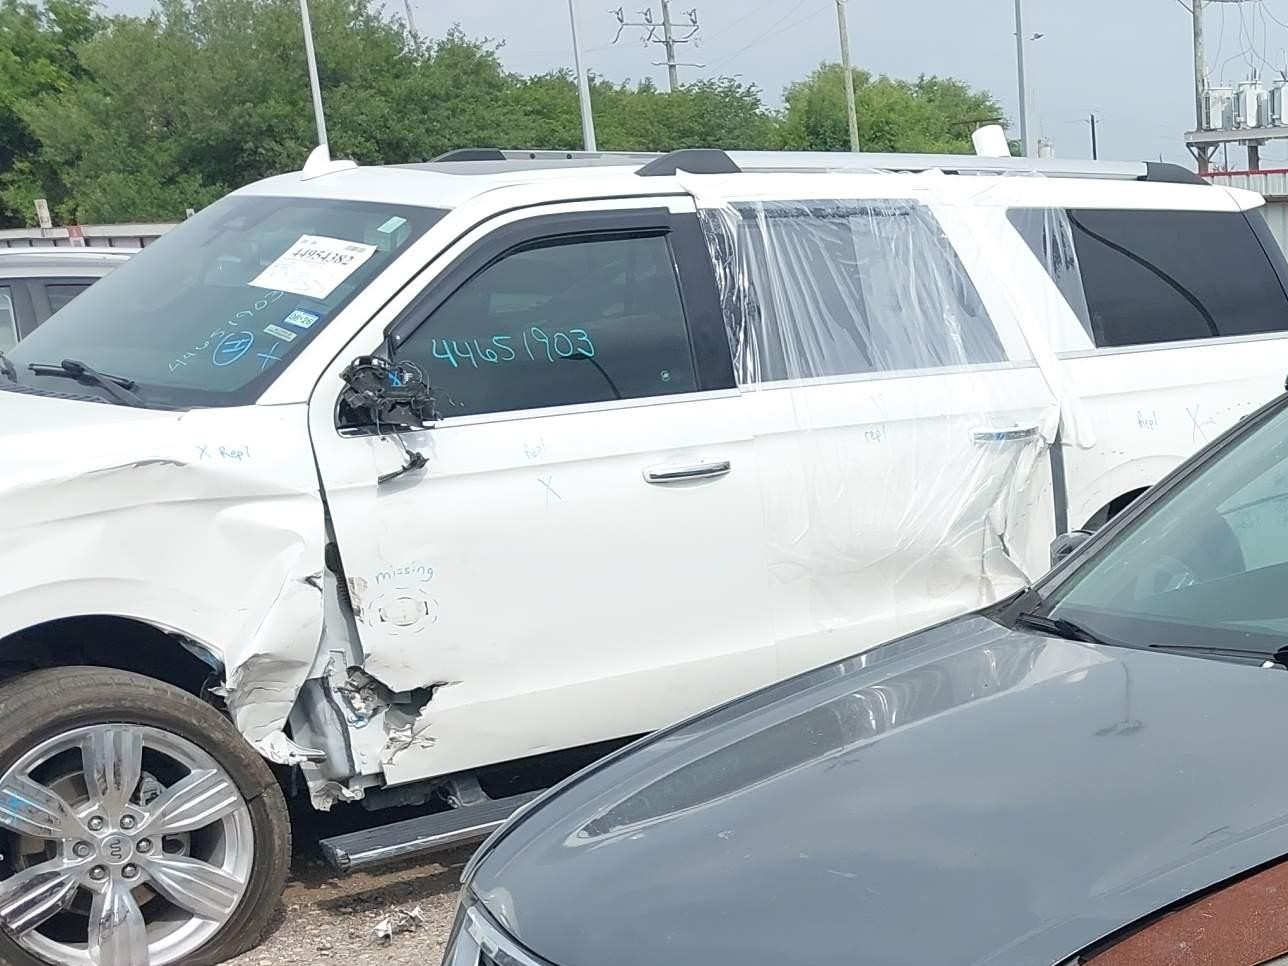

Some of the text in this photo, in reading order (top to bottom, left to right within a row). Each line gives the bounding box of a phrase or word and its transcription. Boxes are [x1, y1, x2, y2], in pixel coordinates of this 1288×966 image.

[292, 248, 355, 266] 44954382
[432, 326, 595, 368] 44651903
[375, 561, 434, 585] missing
